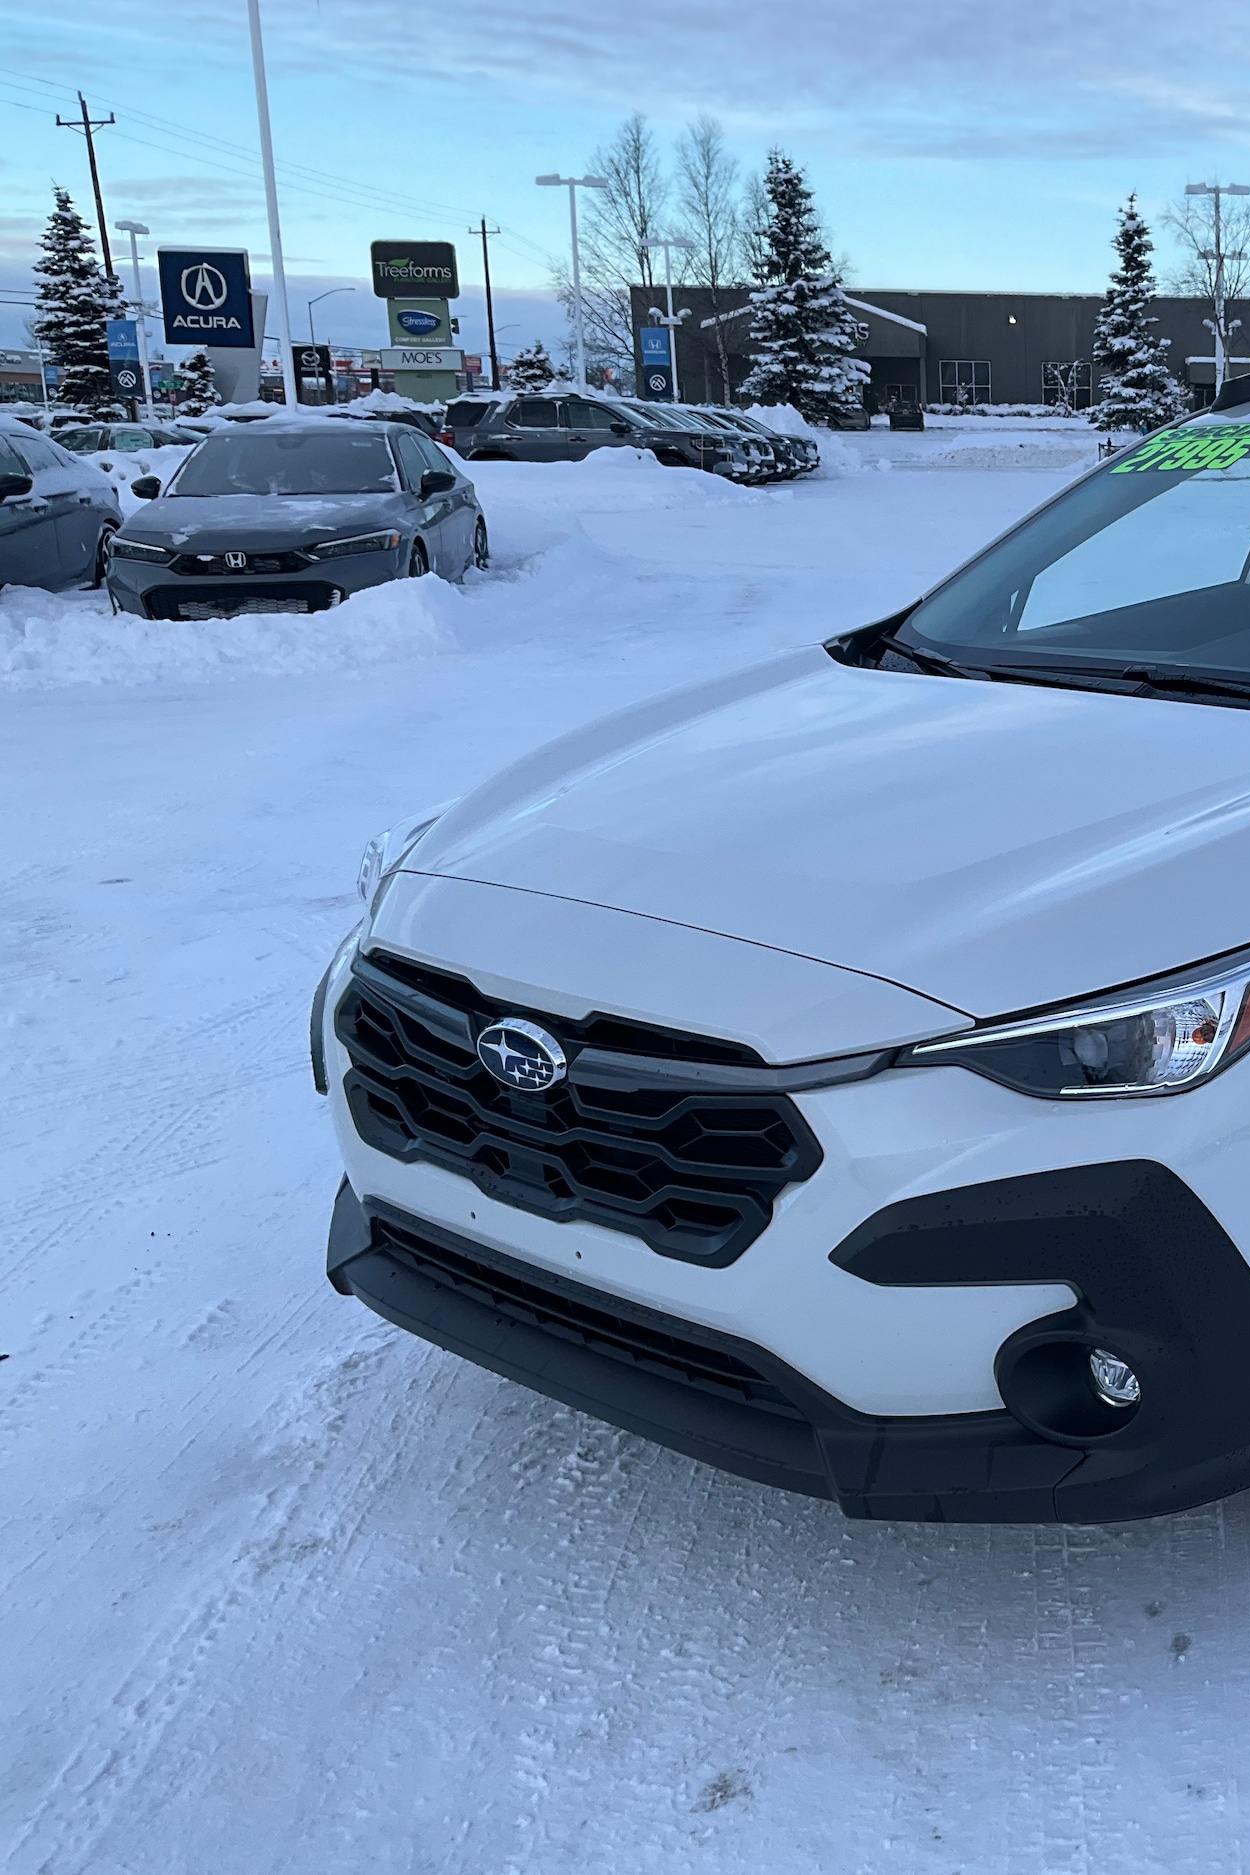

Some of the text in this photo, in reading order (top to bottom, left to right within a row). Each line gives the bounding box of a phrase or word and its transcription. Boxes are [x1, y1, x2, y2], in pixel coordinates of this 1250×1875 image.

[375, 261, 452, 278] Treeforms
[172, 314, 242, 330] ACURA
[402, 316, 436, 327] Stressless
[401, 351, 442, 363] MOE'S
